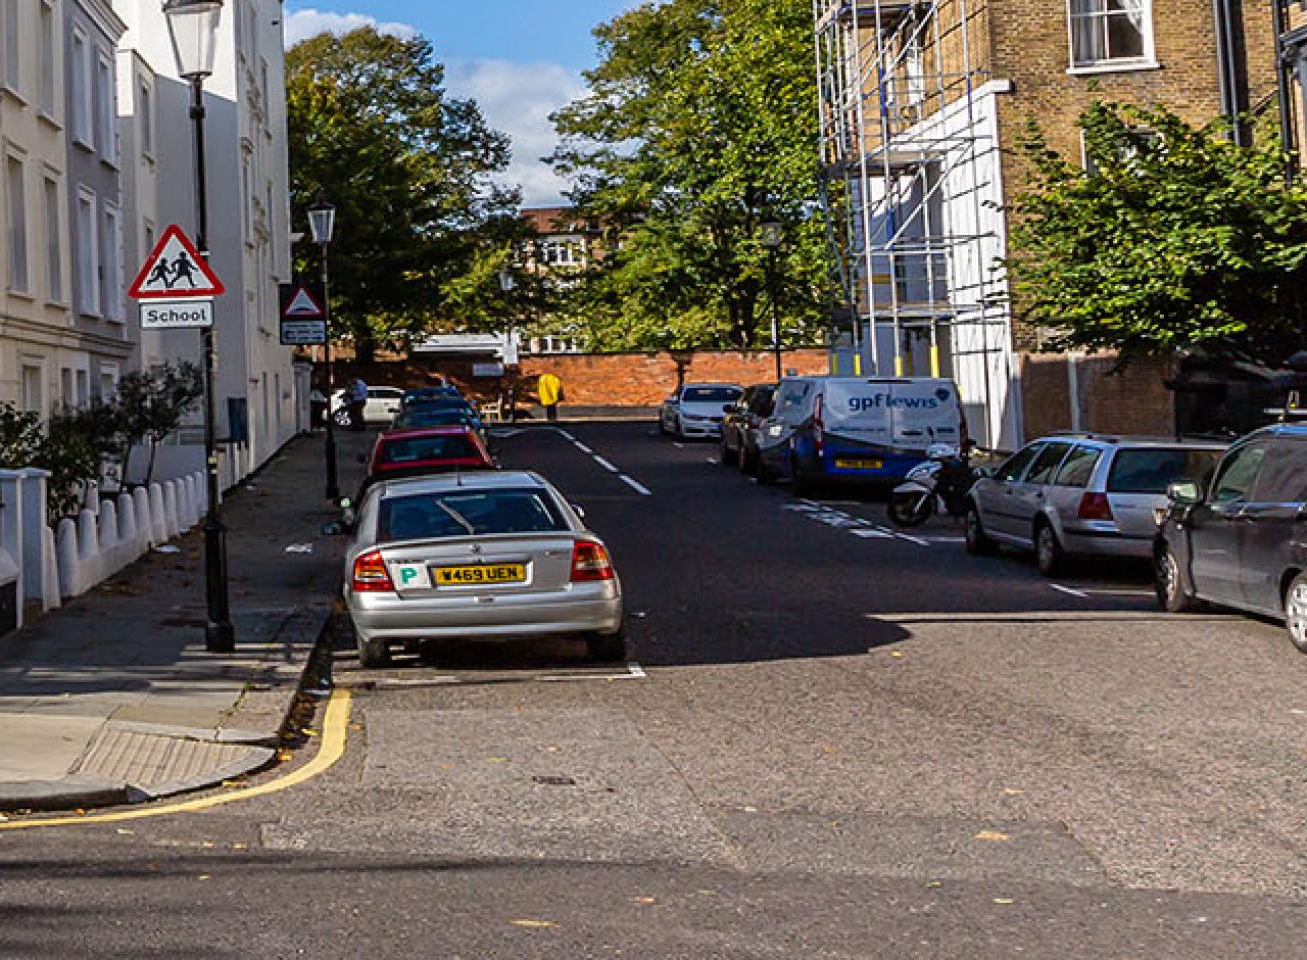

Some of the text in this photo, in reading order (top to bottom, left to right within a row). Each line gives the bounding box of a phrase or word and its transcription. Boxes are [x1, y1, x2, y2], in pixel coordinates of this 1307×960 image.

[147, 308, 207, 323] School
[849, 393, 938, 411] gpf lewis
[400, 567, 418, 584] P
